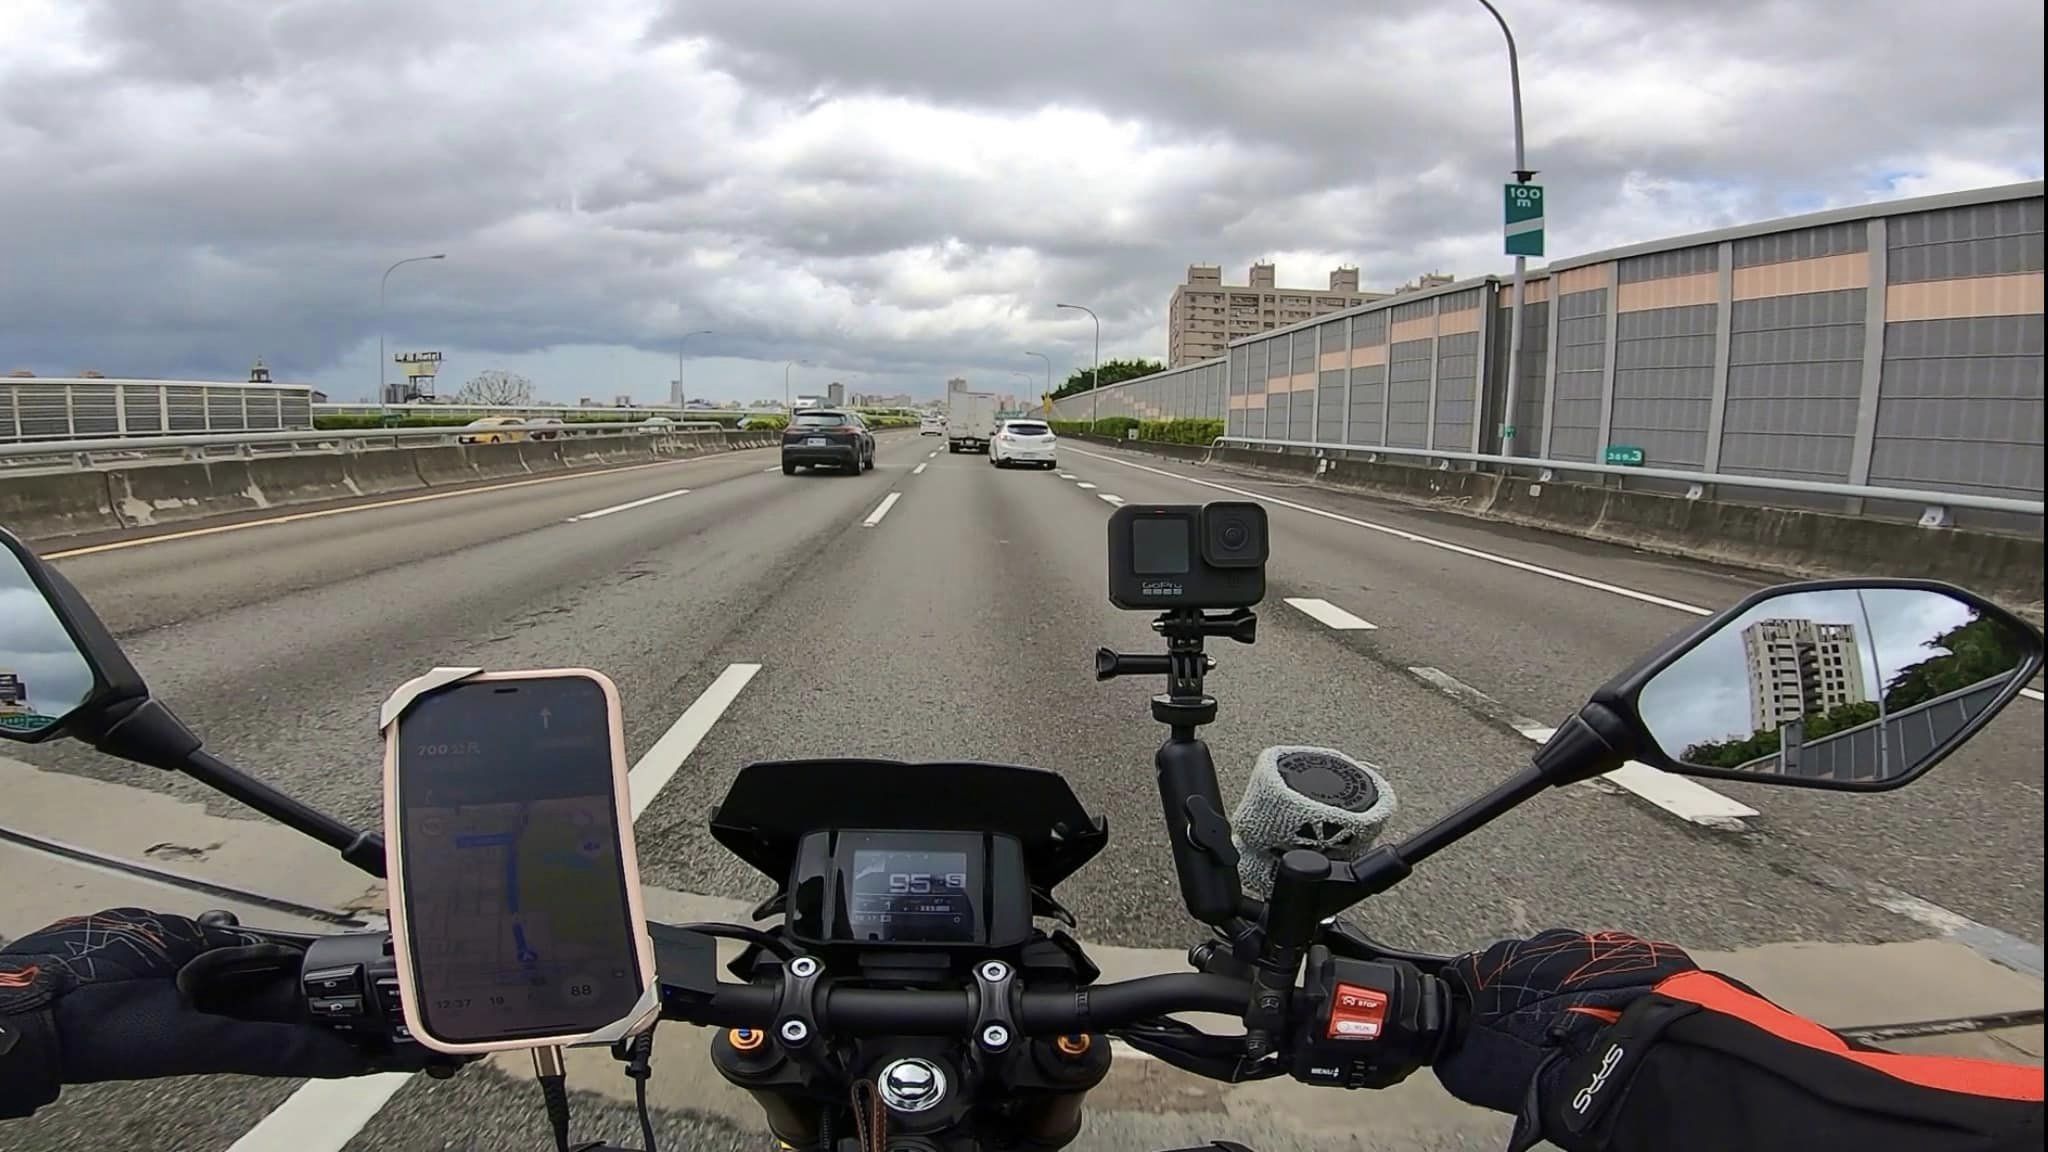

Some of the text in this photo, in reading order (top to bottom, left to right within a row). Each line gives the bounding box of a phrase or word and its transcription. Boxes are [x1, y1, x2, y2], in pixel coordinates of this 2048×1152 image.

[1510, 187, 1541, 199] 100
[1517, 199, 1531, 207] m
[889, 873, 931, 894] 95
[570, 984, 593, 997] 88
[1357, 1000, 1378, 1008] STOP
[1573, 1043, 1624, 1114] SPRS
